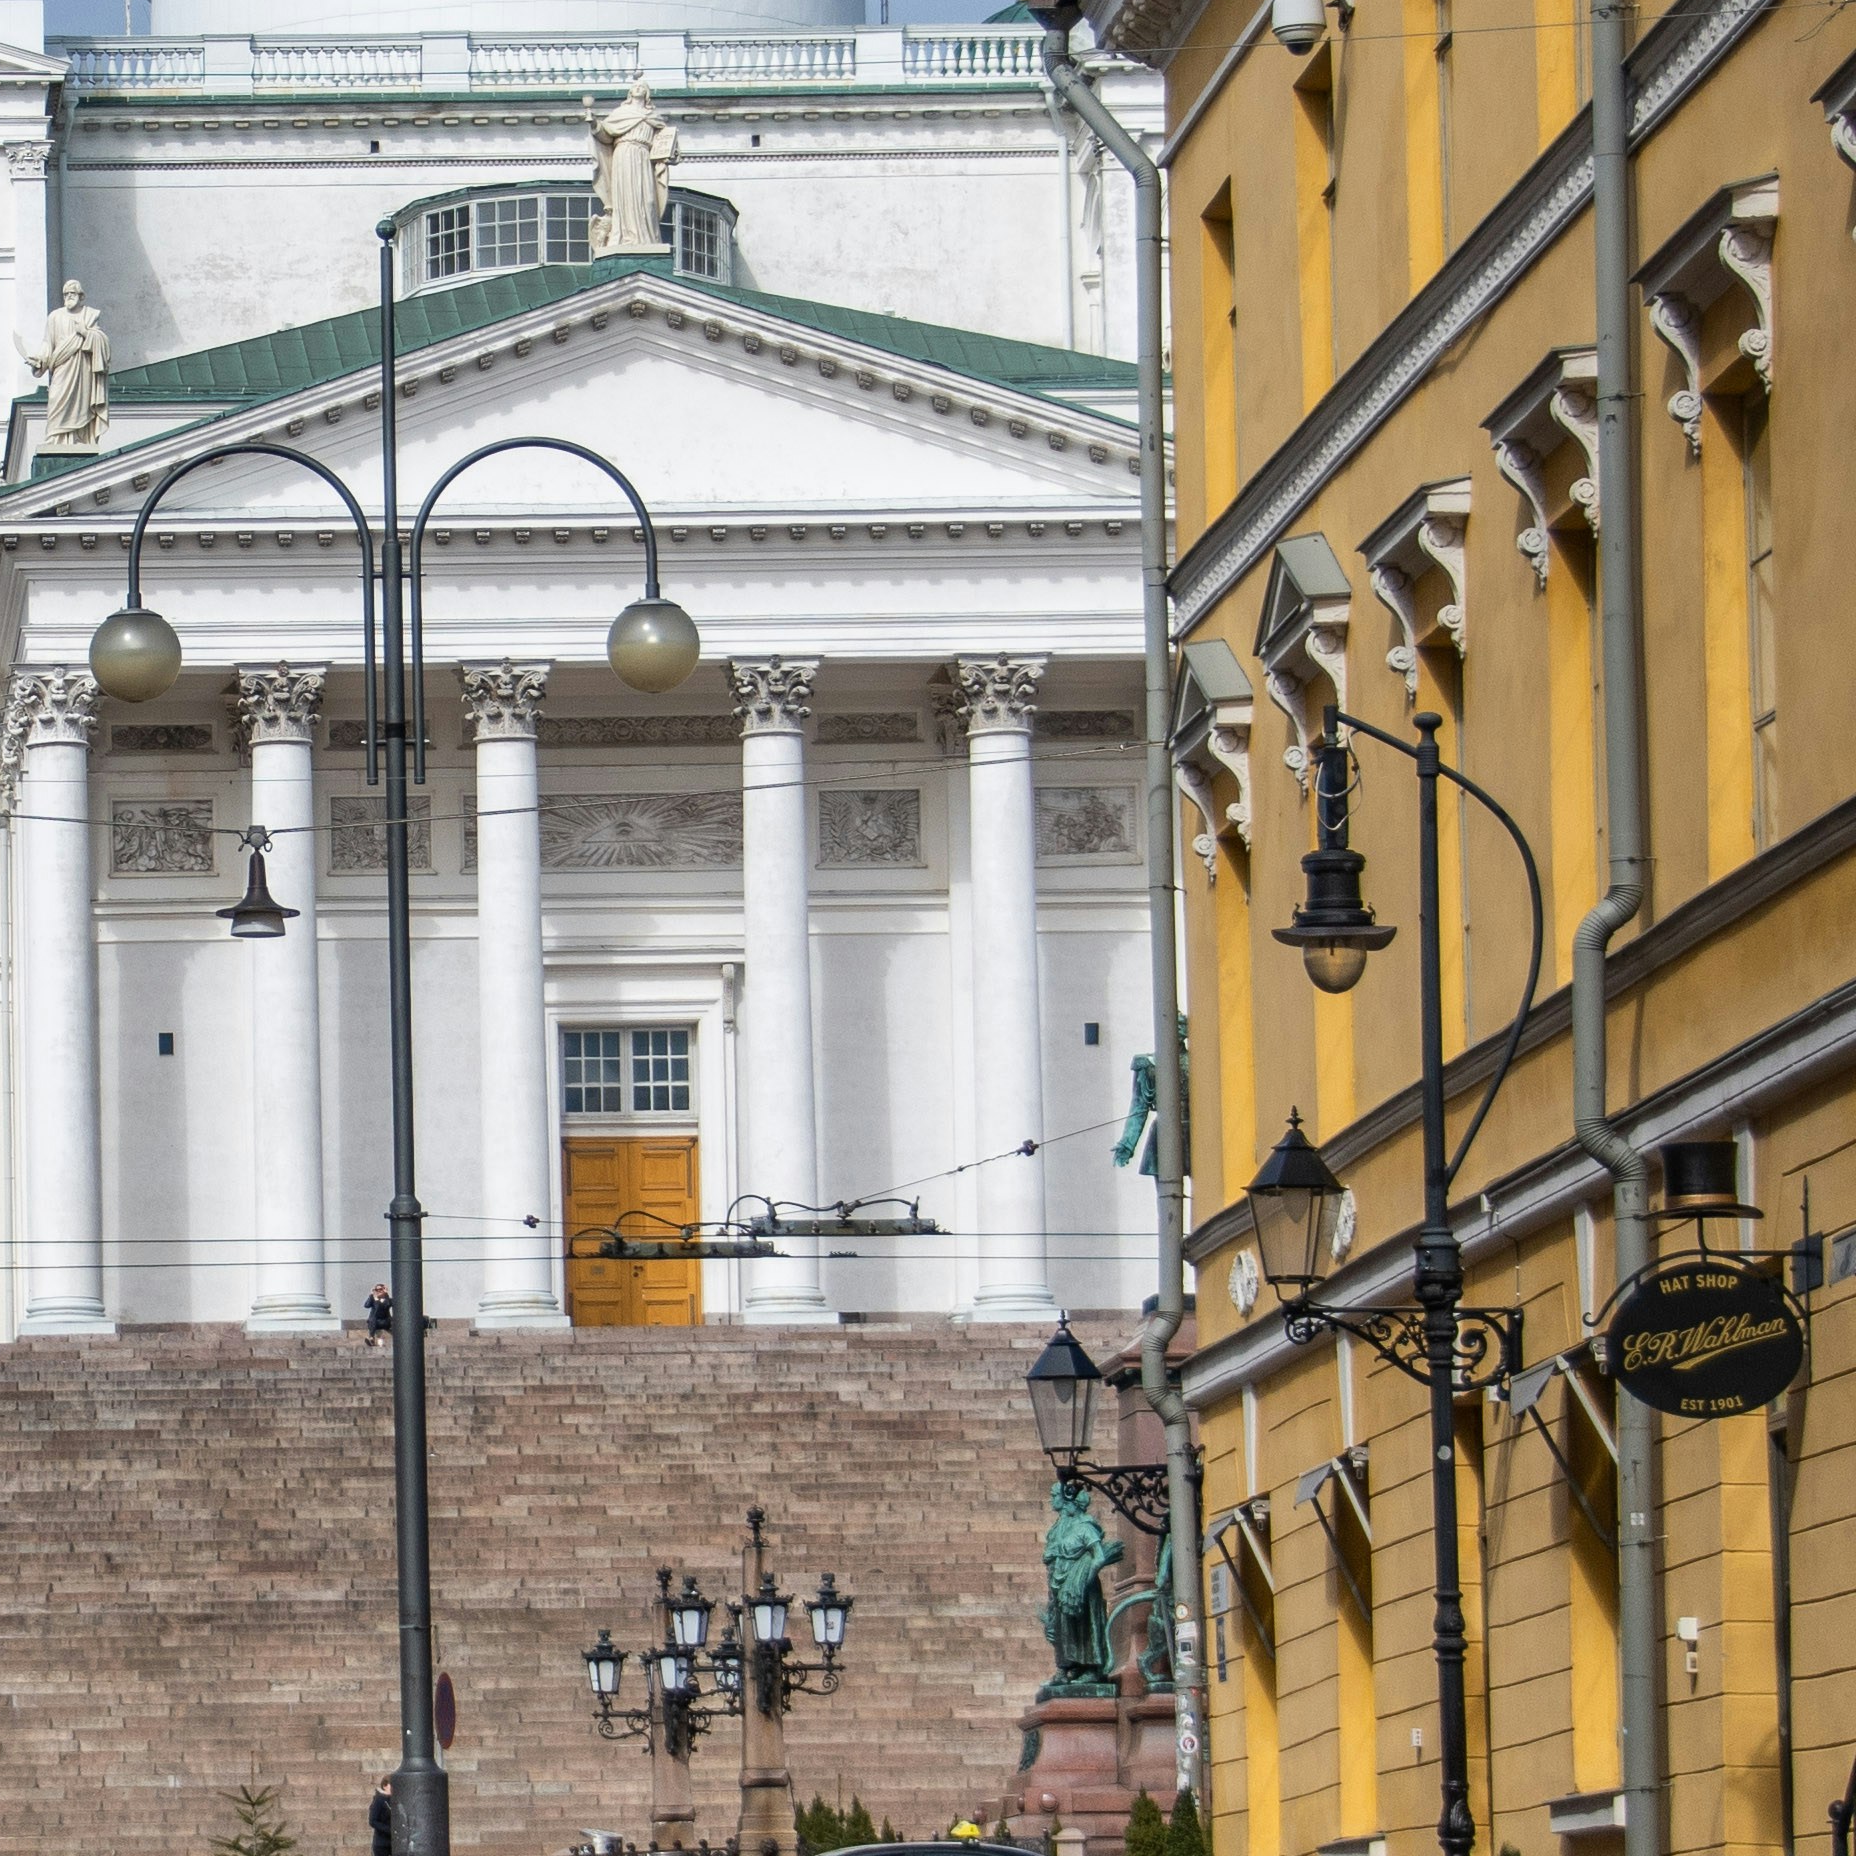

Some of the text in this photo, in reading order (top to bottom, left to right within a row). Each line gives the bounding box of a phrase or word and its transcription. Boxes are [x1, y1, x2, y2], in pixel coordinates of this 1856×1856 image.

[1659, 1274, 1738, 1294] HAT SHOP
[1680, 1395, 1744, 1411] EST 1901
